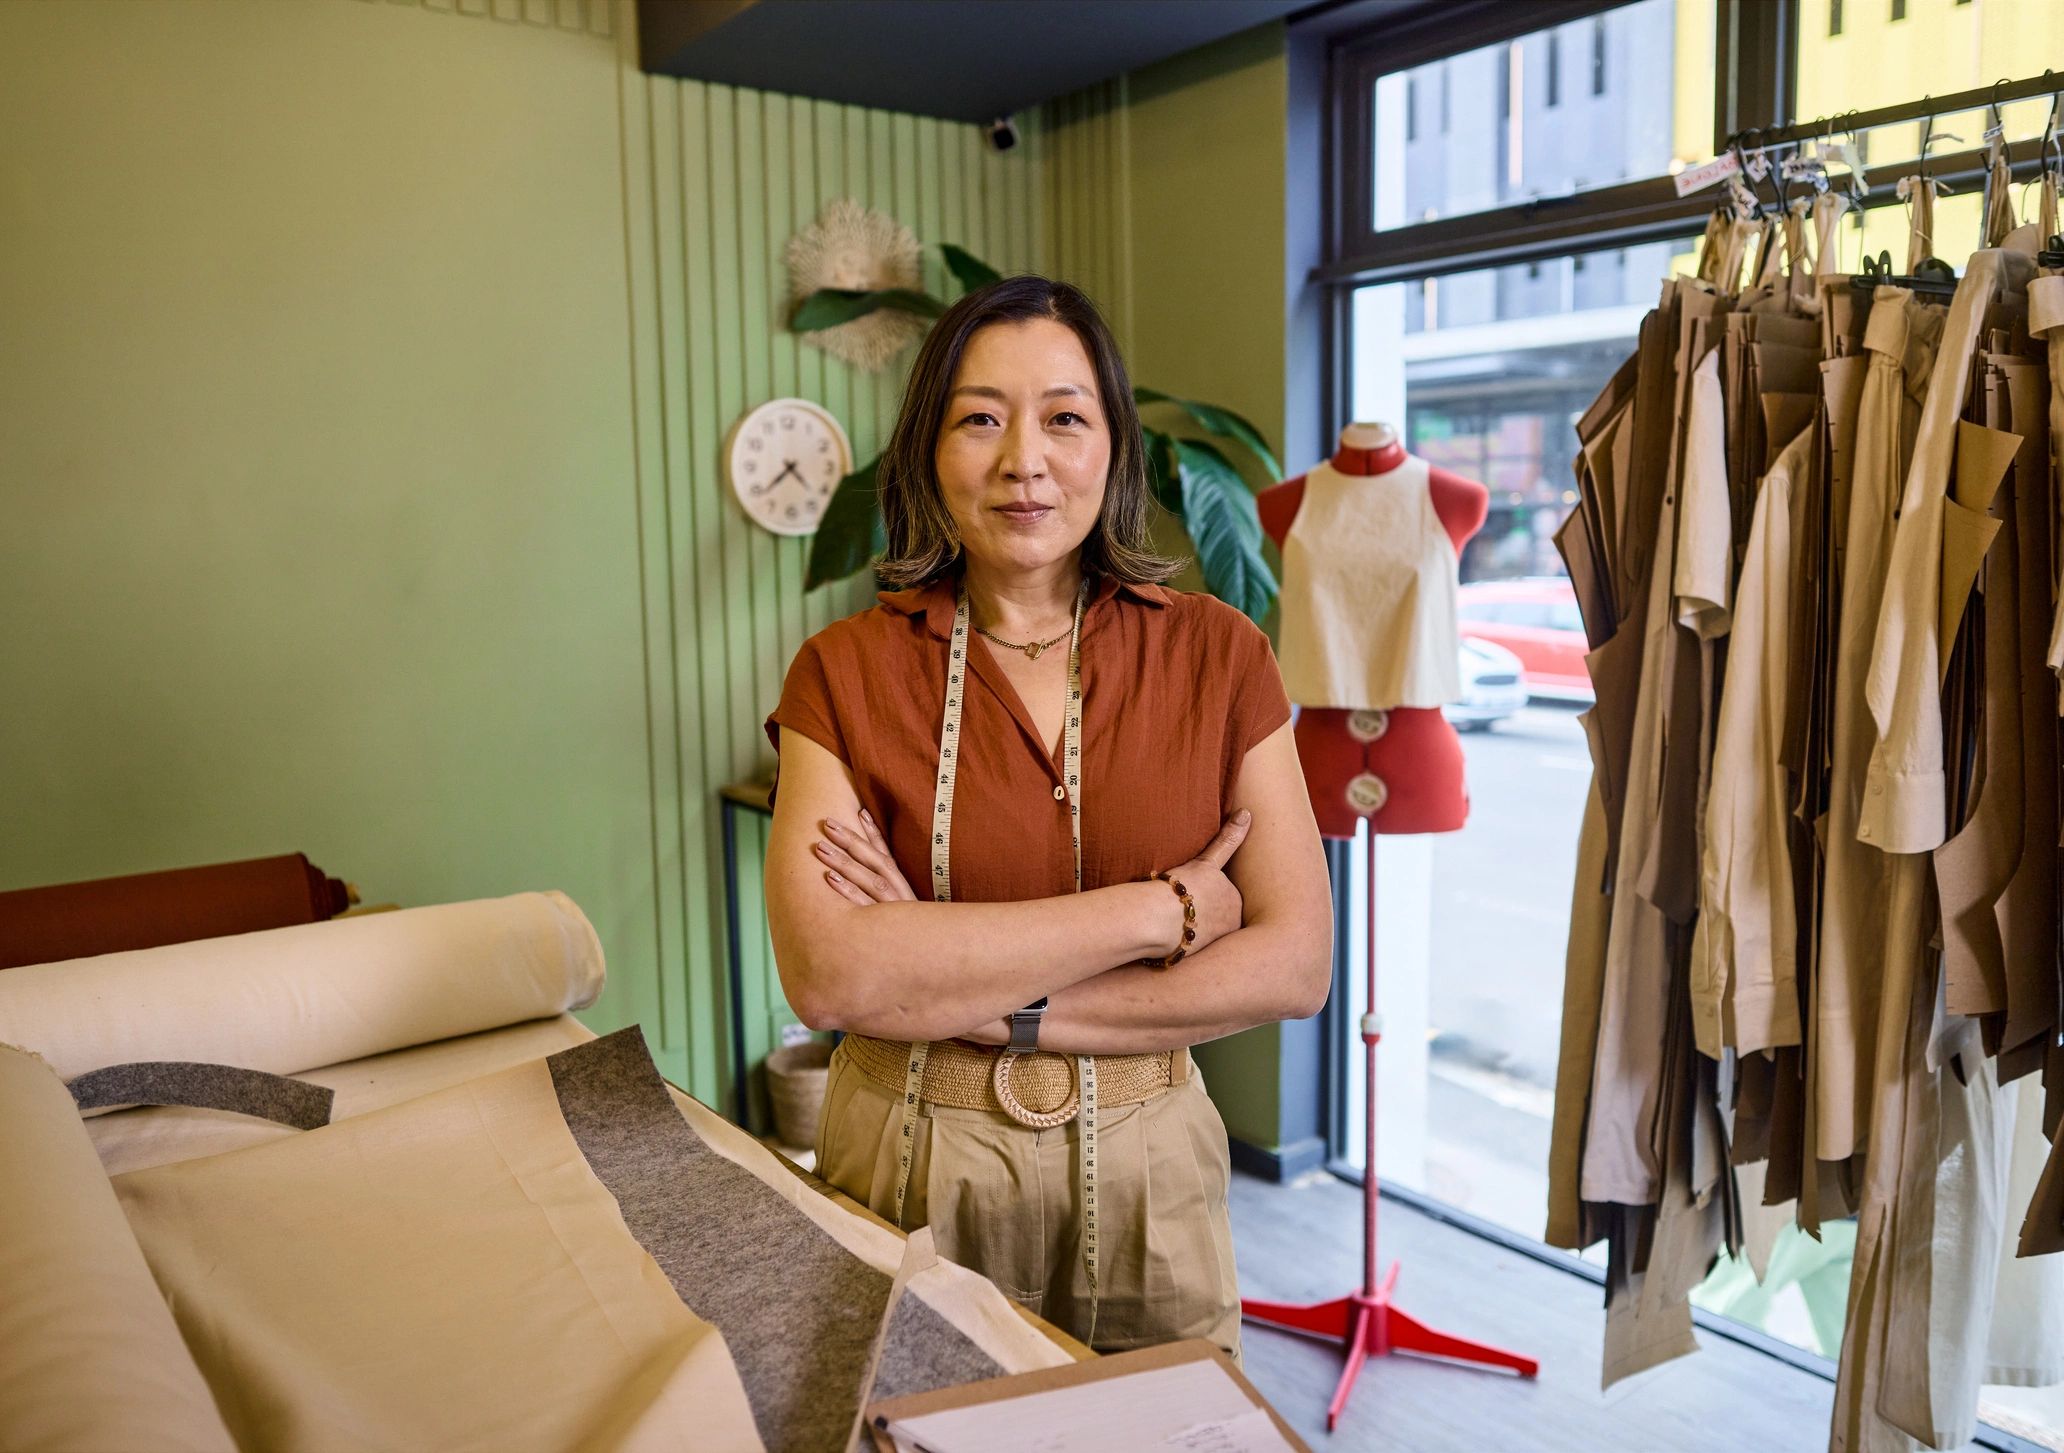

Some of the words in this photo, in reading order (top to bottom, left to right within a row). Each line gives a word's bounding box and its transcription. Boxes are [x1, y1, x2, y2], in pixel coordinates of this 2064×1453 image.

[958, 607, 964, 616] 37
[956, 628, 962, 636] 38
[953, 650, 960, 659] 39
[951, 674, 958, 684] 40
[1072, 690, 1080, 700] 23
[948, 698, 956, 708] 41
[946, 722, 954, 732] 42
[1071, 717, 1078, 728] 22
[944, 748, 951, 758] 43
[1070, 746, 1078, 756] 21
[940, 774, 949, 784] 44
[1070, 775, 1078, 786] 20
[938, 802, 946, 813] 45
[1072, 805, 1077, 816] 19
[935, 832, 944, 844] 46
[935, 864, 944, 876] 47
[910, 1060, 918, 1072] 54
[908, 1092, 916, 1104] 55
[904, 1124, 910, 1137] 56
[902, 1156, 908, 1168] 57
[1088, 1258, 1095, 1266] 12
